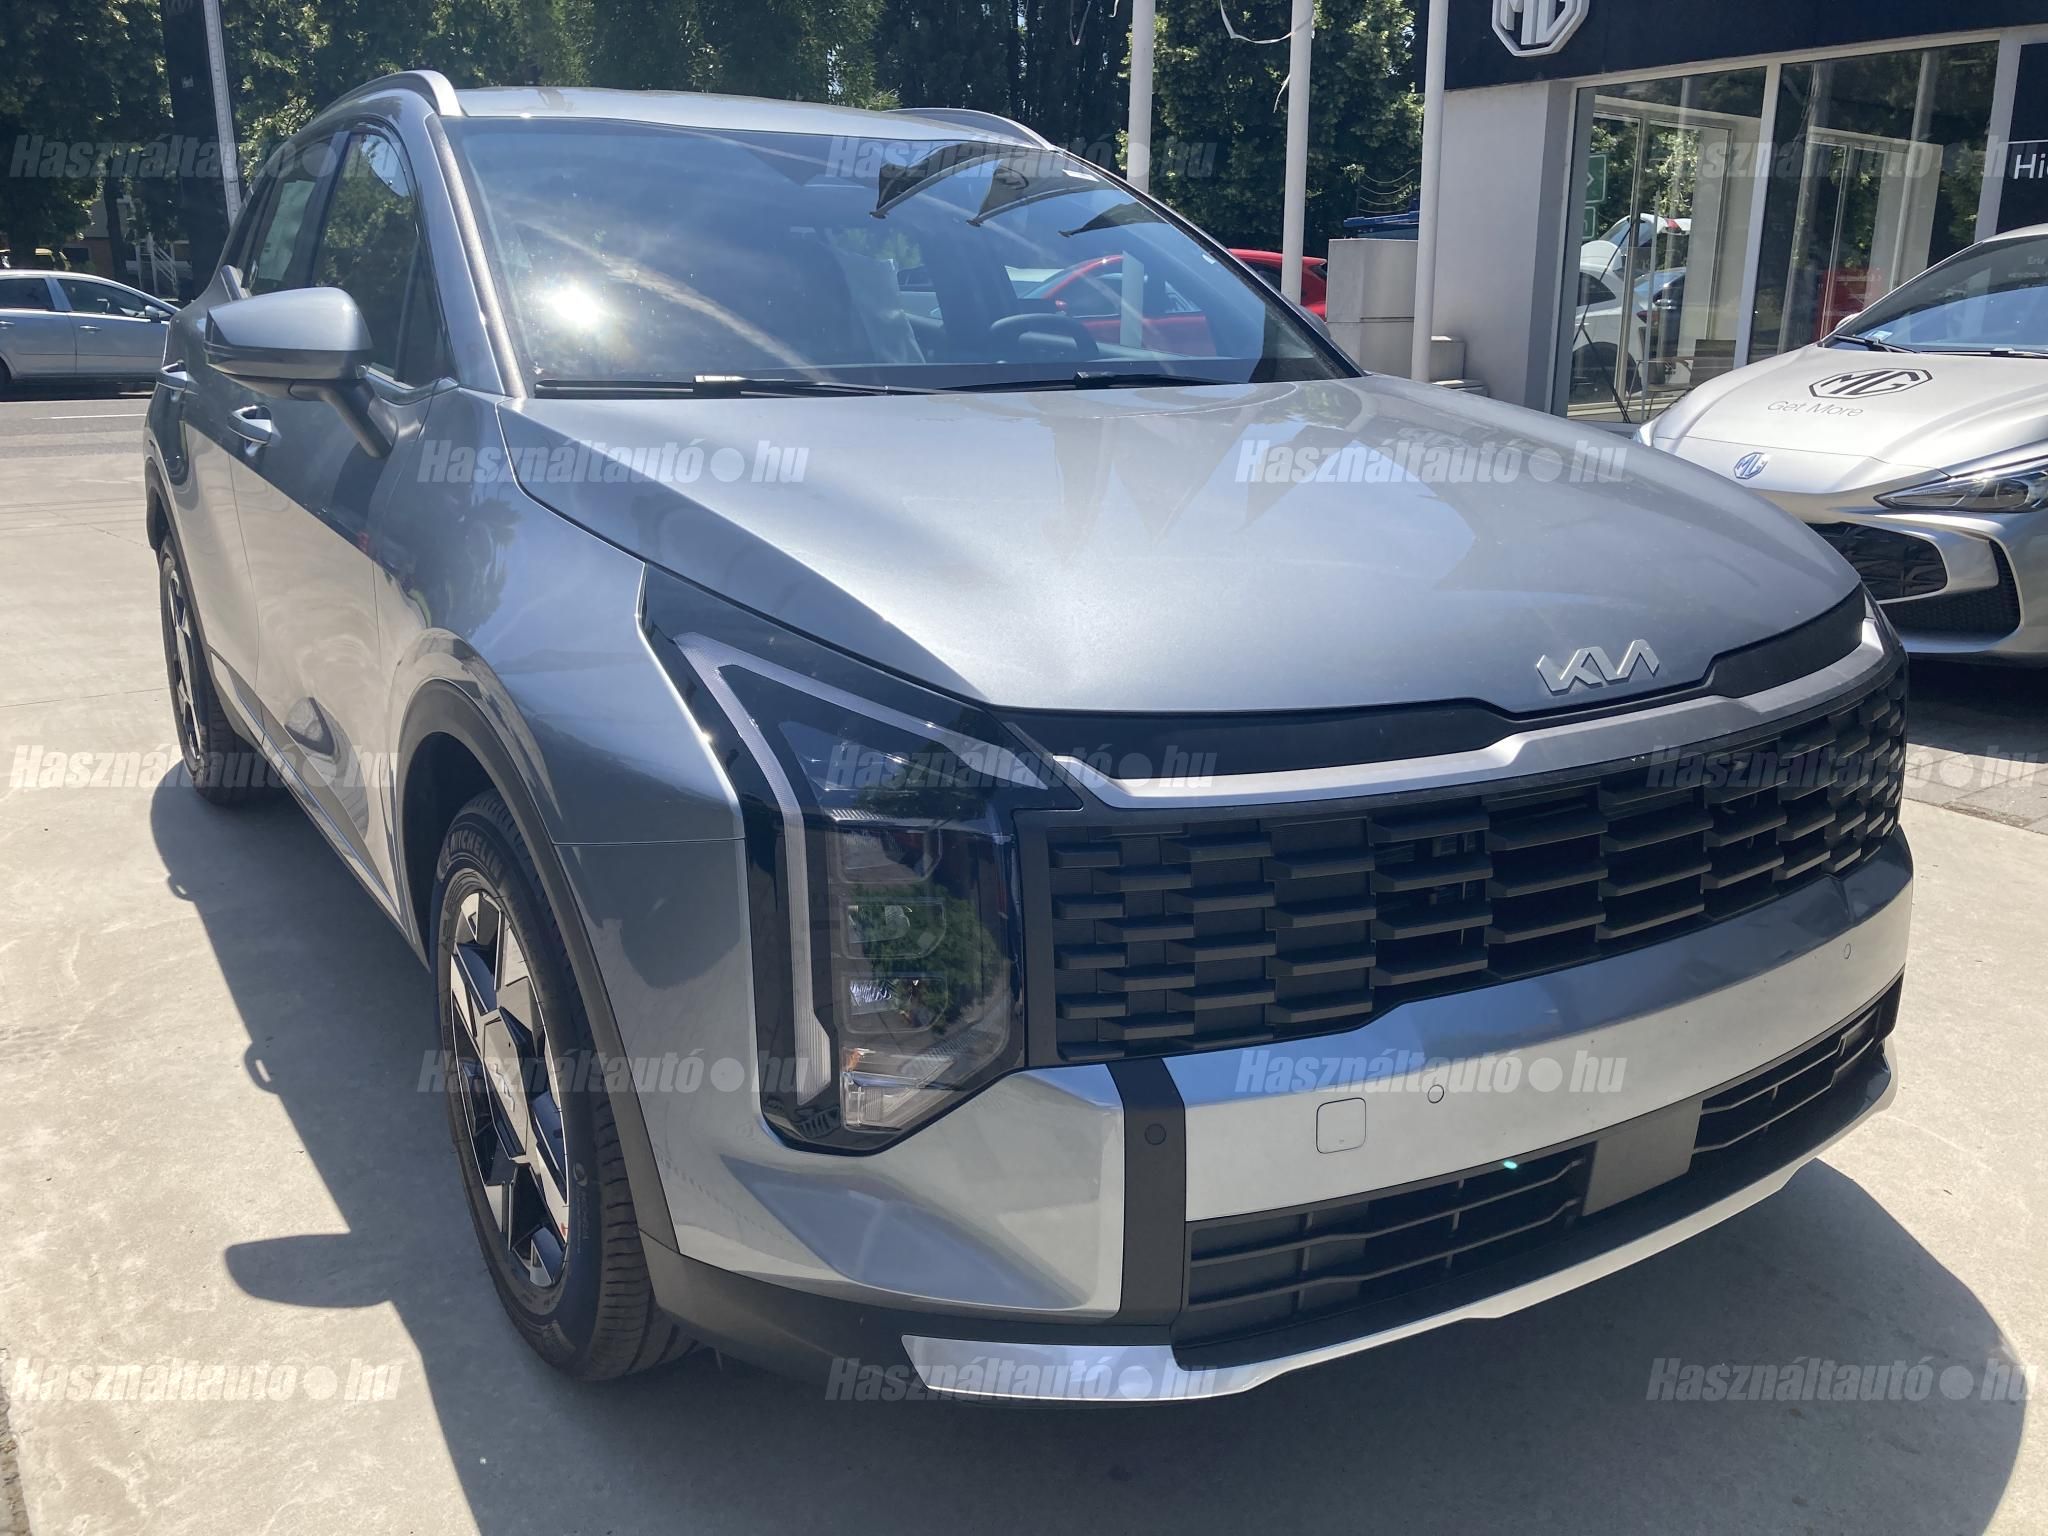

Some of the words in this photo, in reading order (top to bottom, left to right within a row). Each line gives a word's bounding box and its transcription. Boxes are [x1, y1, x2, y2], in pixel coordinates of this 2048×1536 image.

[2013, 153, 2048, 180] Hi
[1818, 369, 1922, 397] MG
[1767, 400, 1805, 413] Get
[1806, 403, 1864, 417] More
[1735, 453, 1768, 478] MG
[449, 828, 503, 881] MICHELIN
